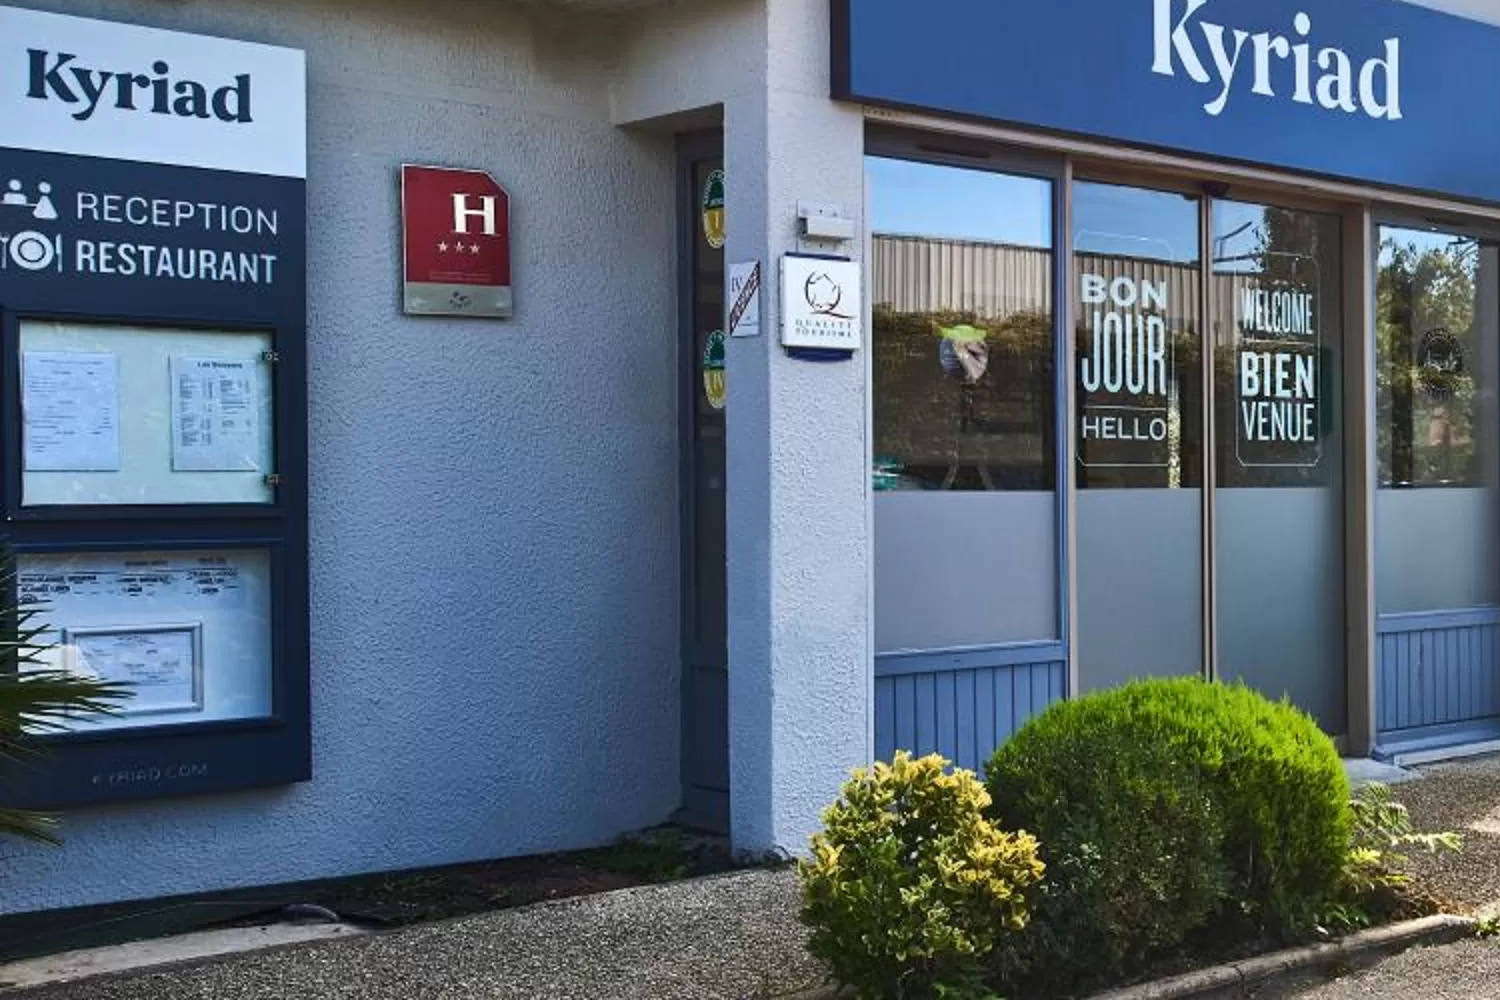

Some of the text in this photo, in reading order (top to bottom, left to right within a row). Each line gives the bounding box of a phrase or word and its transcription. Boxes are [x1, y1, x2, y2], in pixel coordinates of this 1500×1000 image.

[26, 48, 253, 123] Kyriad
[76, 191, 278, 235] RECEPTION
[451, 193, 499, 235] H
[76, 239, 277, 283] RESTAURANT
[1081, 273, 1168, 311] BON
[1241, 286, 1313, 335] WELCOME
[1081, 311, 1167, 396] JOUR
[1241, 351, 1315, 399] BIEN
[1082, 416, 1168, 442] HELLO
[1241, 401, 1315, 442] VENUE
